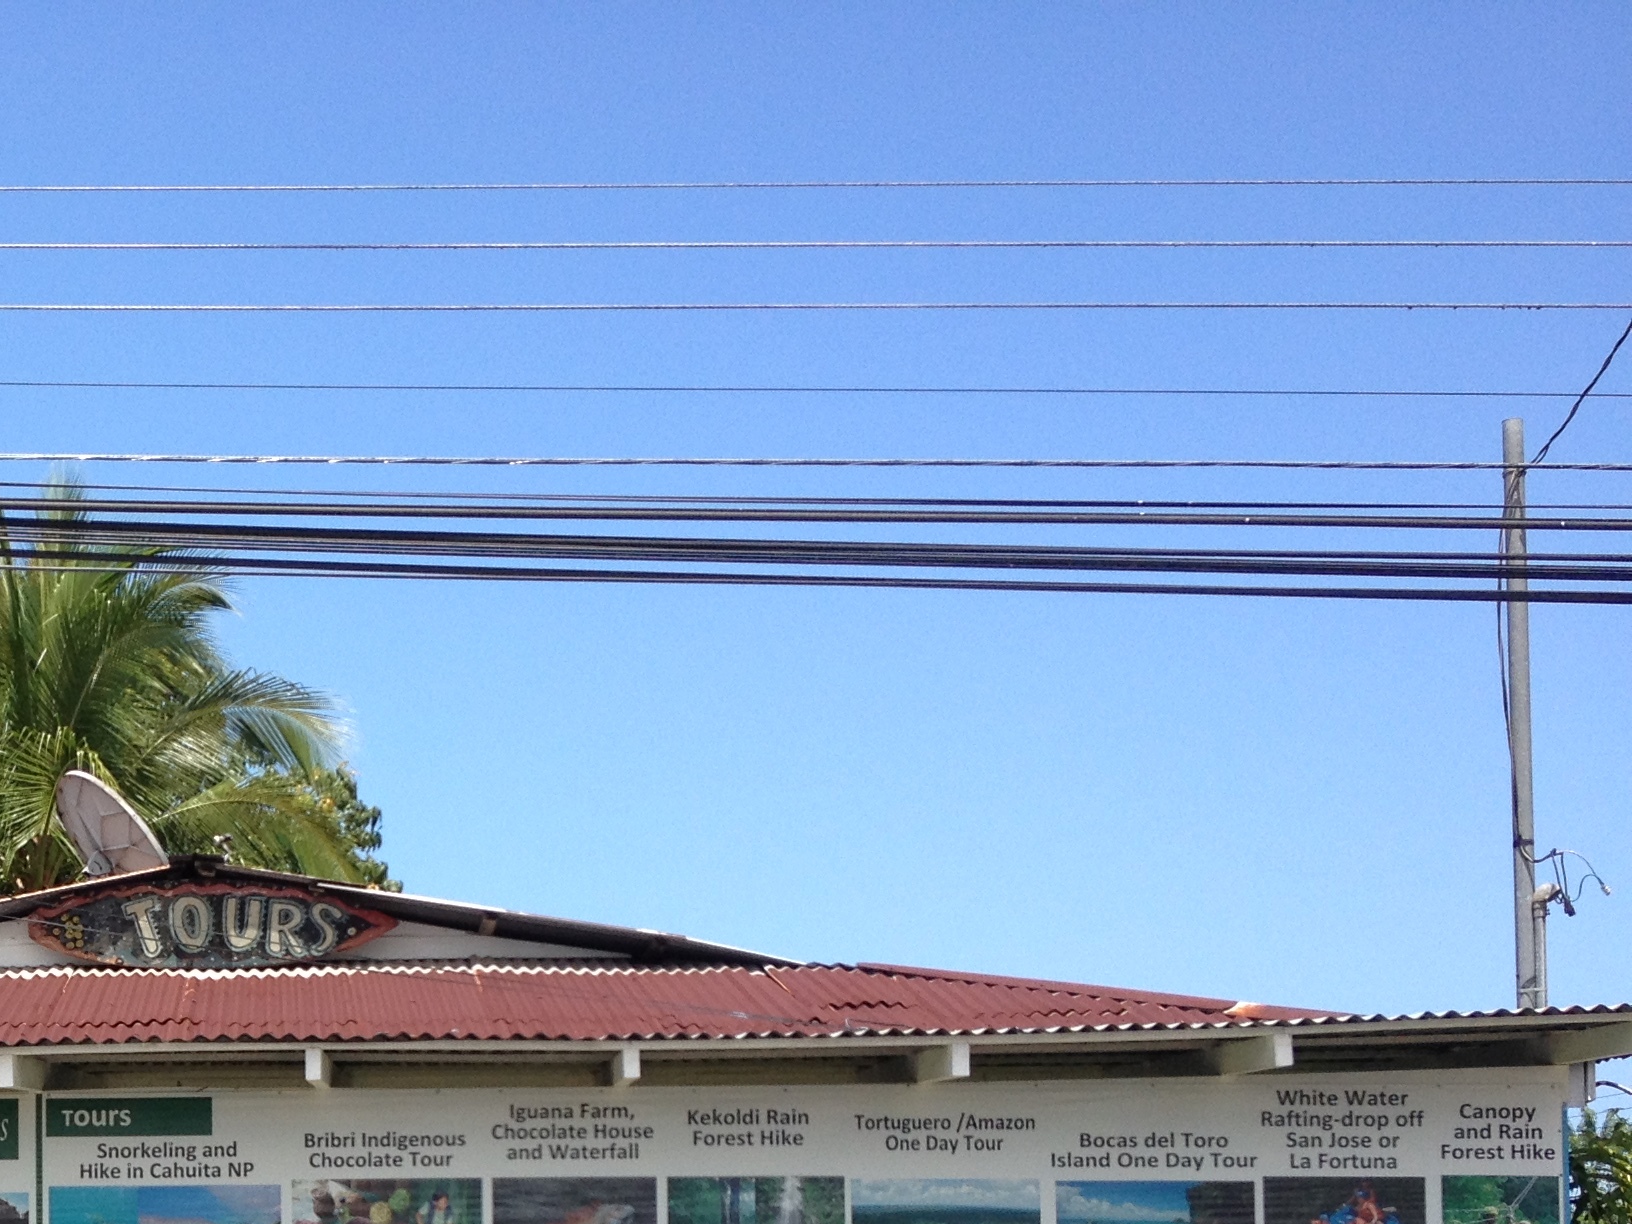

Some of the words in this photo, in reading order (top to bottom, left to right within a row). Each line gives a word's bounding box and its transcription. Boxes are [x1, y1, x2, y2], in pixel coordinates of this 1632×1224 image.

[121, 894, 349, 958] TOURS
[1276, 1090, 1338, 1107] White
[1348, 1090, 1408, 1106] Water
[510, 1104, 574, 1123] Iguana
[580, 1104, 635, 1121] Farm,
[687, 1108, 759, 1126] Kekoldi
[767, 1108, 809, 1125] Rain
[855, 1114, 951, 1133] Tortuguero
[956, 1113, 1035, 1133] /Amazon
[1261, 1111, 1388, 1130] Rafting-drop
[1396, 1110, 1424, 1128] off
[1459, 1104, 1535, 1123] Canopy
[492, 1122, 587, 1141] Chocolate
[595, 1123, 654, 1140] House
[693, 1130, 753, 1147] Forest
[760, 1129, 803, 1146] Hike
[1080, 1132, 1137, 1149] Bocas
[1144, 1132, 1174, 1148] del
[1181, 1132, 1228, 1148] Toro
[1286, 1132, 1321, 1149] San
[1328, 1132, 1371, 1149] Jose
[1379, 1135, 1400, 1148] or
[1454, 1124, 1491, 1141] and
[1500, 1124, 1543, 1141] Rain
[97, 1142, 196, 1161] Snorkeling
[202, 1141, 237, 1158] and
[304, 1133, 356, 1148] Bribri
[362, 1132, 466, 1152] Indigenous
[507, 1142, 542, 1161] and
[548, 1142, 639, 1161] Waterfall
[885, 1136, 919, 1152] One
[926, 1136, 958, 1155] Day
[964, 1136, 1004, 1152] Tour
[309, 1152, 402, 1168] Chocolate
[408, 1153, 452, 1167] Tour
[1051, 1152, 1112, 1169] Island
[1120, 1152, 1158, 1169] One
[1165, 1152, 1202, 1171] Day
[1209, 1152, 1258, 1168] Tour
[1290, 1154, 1313, 1170] La
[1319, 1154, 1397, 1170] Fortuna
[1441, 1144, 1503, 1161] Forest
[1511, 1144, 1555, 1161] Hike
[80, 1162, 121, 1180] Hike
[127, 1162, 144, 1179] in
[150, 1162, 221, 1179] Cahuita
[228, 1162, 254, 1178] NP
